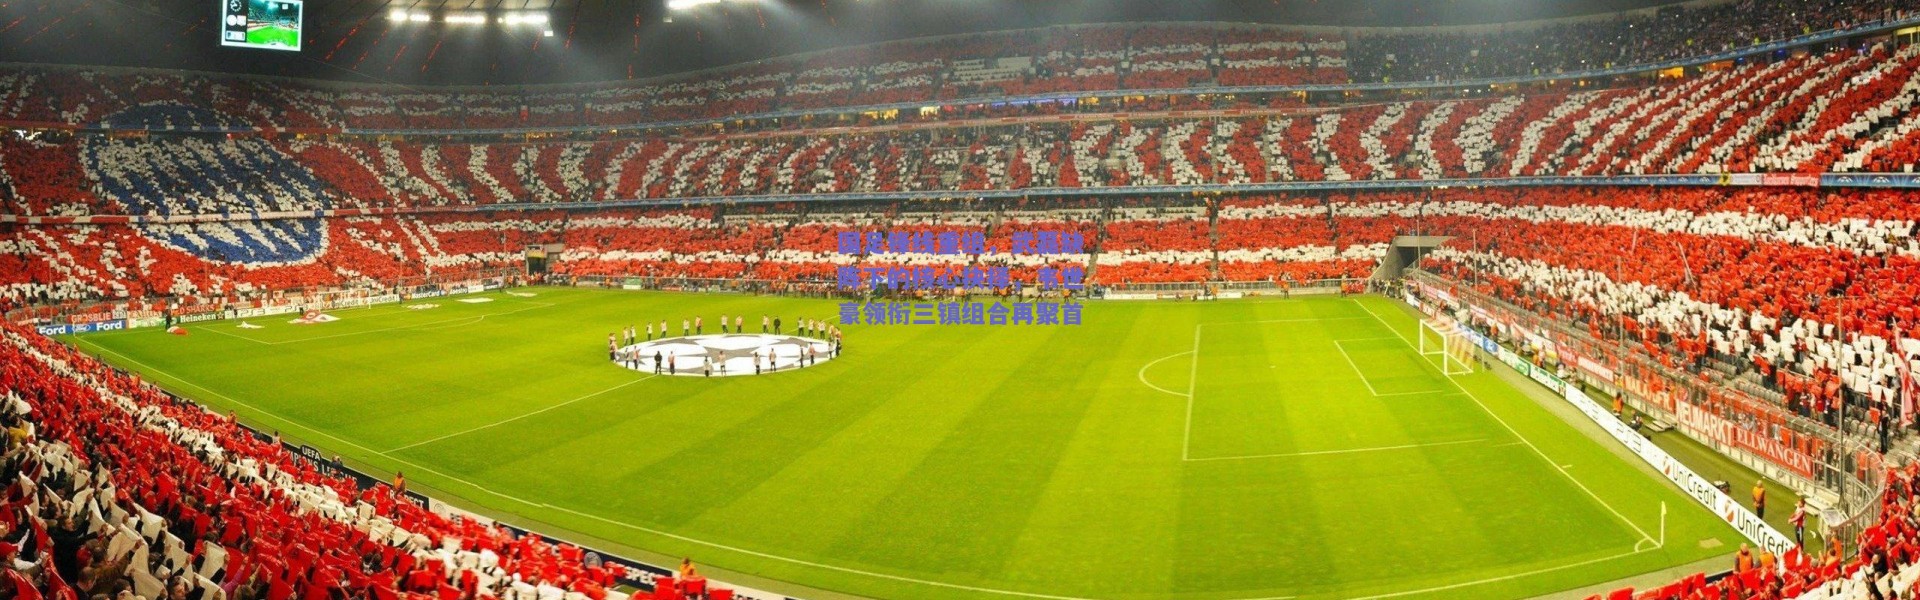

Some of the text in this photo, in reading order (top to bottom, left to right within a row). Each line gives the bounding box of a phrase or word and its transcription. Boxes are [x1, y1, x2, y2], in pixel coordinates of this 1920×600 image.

[180, 311, 217, 324] Heineken
[38, 325, 67, 336] Ford
[96, 320, 123, 331] Ford
[1676, 398, 1734, 447] NEUMARKT
[301, 446, 321, 461] UEFA
[1737, 428, 1813, 475] ELLWANGEN
[1672, 463, 1718, 511] UniCredit
